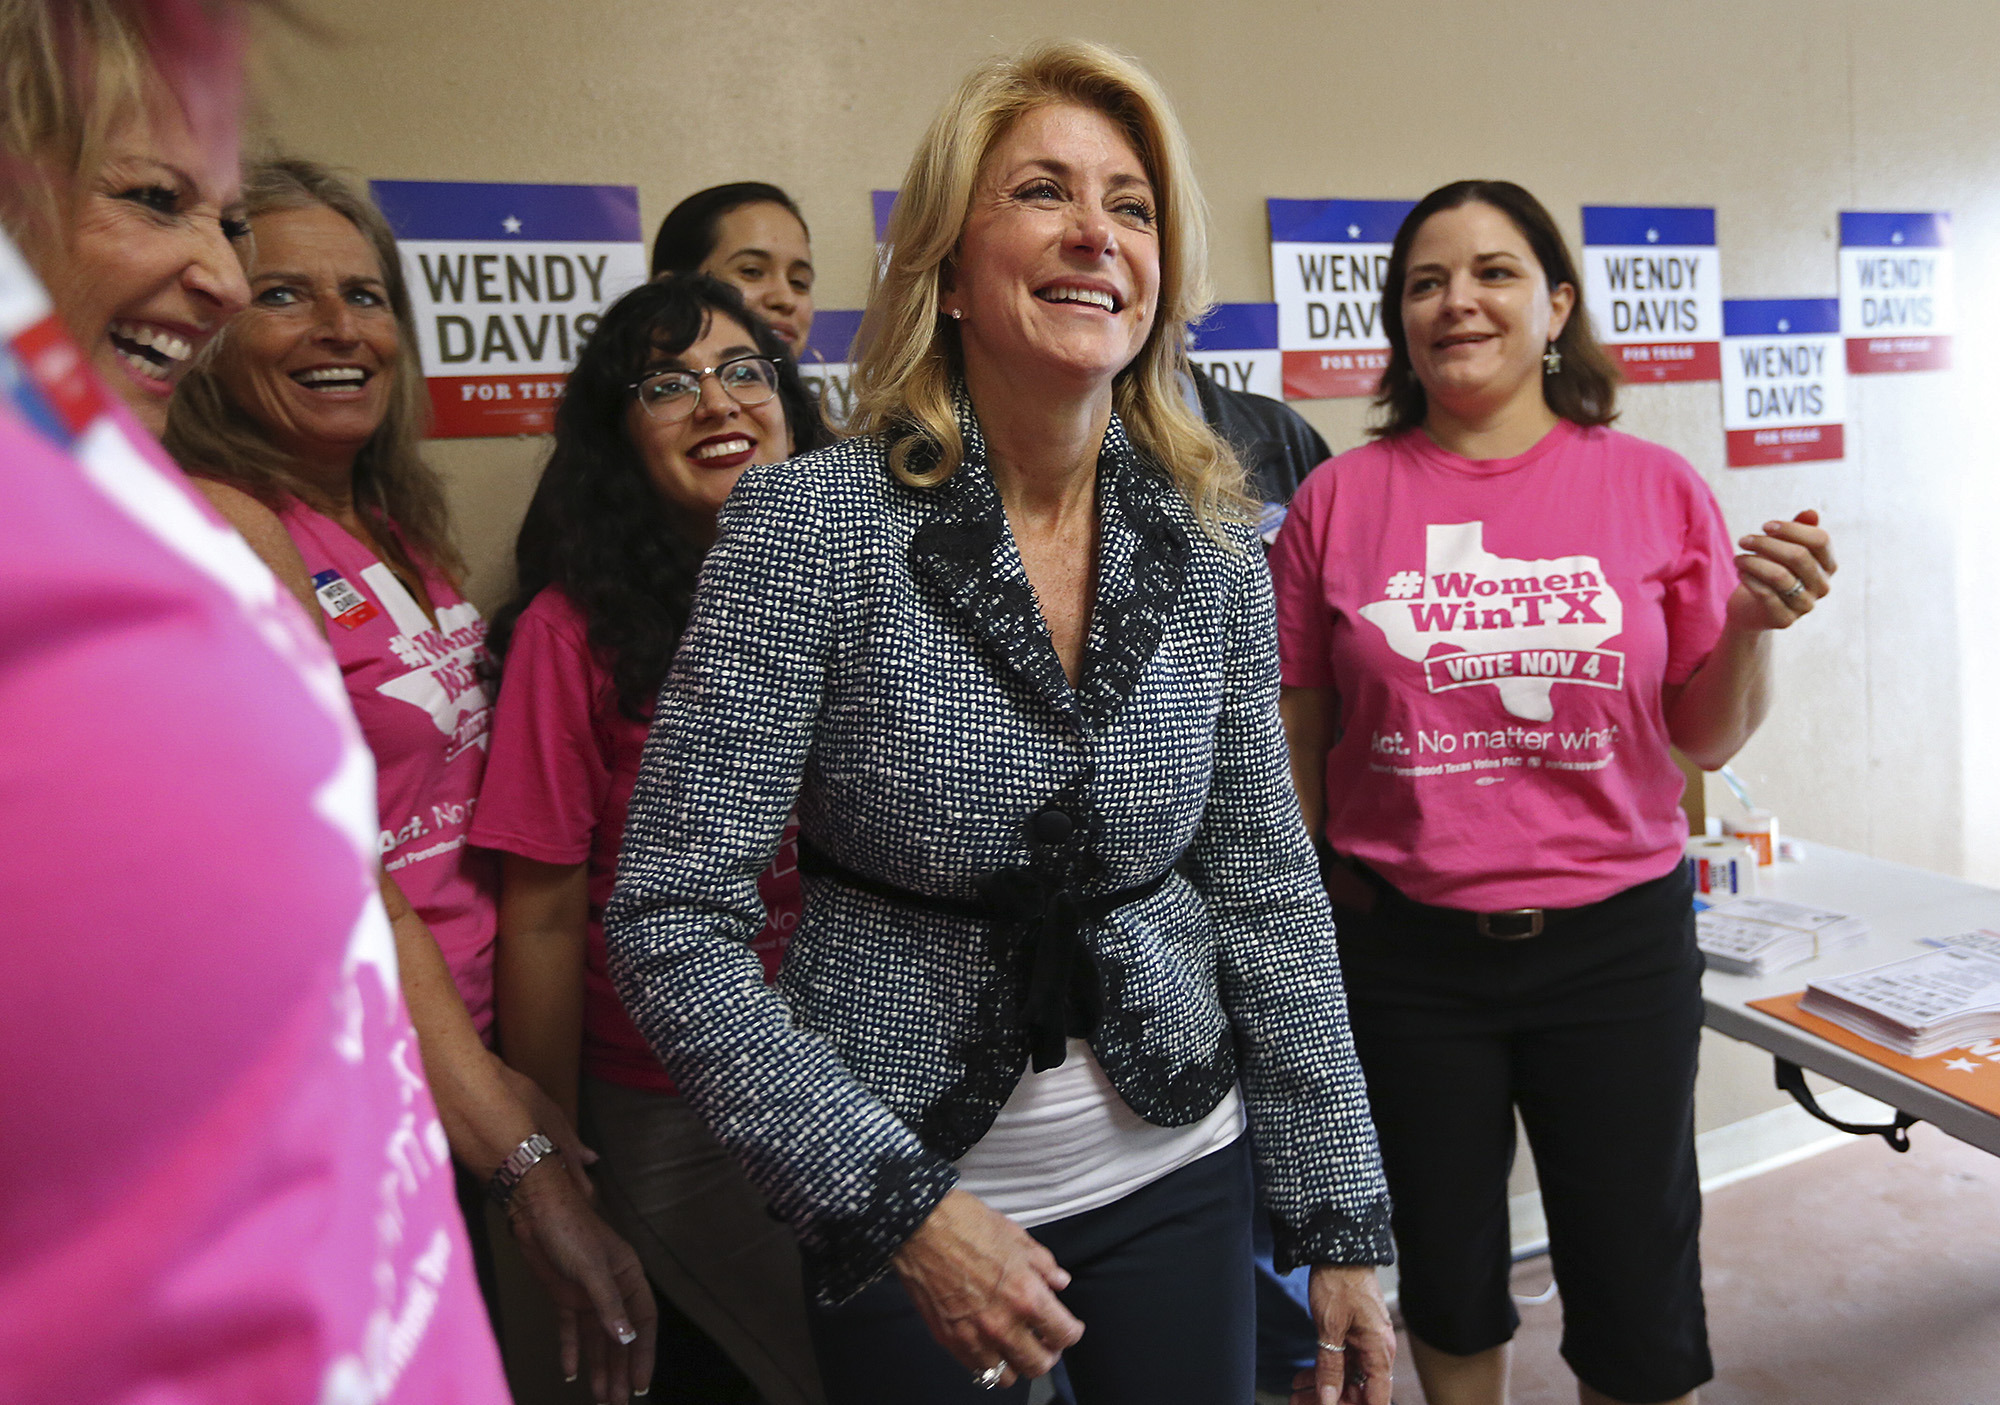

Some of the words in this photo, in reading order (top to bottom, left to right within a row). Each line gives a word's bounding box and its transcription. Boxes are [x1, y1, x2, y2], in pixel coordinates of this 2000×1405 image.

[418, 254, 608, 303] WENDY
[1297, 254, 1390, 292] WEND
[1605, 257, 1700, 290] WENDY
[1857, 257, 1935, 288] WENDY
[1307, 302, 1381, 339] DAV
[1613, 299, 1698, 332] DAVIS
[1862, 297, 1933, 327] DAVIS
[1320, 355, 1353, 370] FOR
[1355, 354, 1388, 369] TEX
[1740, 346, 1825, 377] WENDY
[461, 384, 512, 401] FOR
[518, 382, 567, 399] TEX
[1747, 384, 1824, 418] DAVIS
[1407, 590, 1606, 632] WinTX
[1445, 653, 1513, 682] VOTE
[1520, 651, 1578, 676] NOV
[1581, 654, 1600, 679] 4
[1371, 730, 1411, 756] Act.
[1417, 729, 1457, 754] No
[1463, 726, 1554, 750] matter
[432, 801, 465, 830] No
